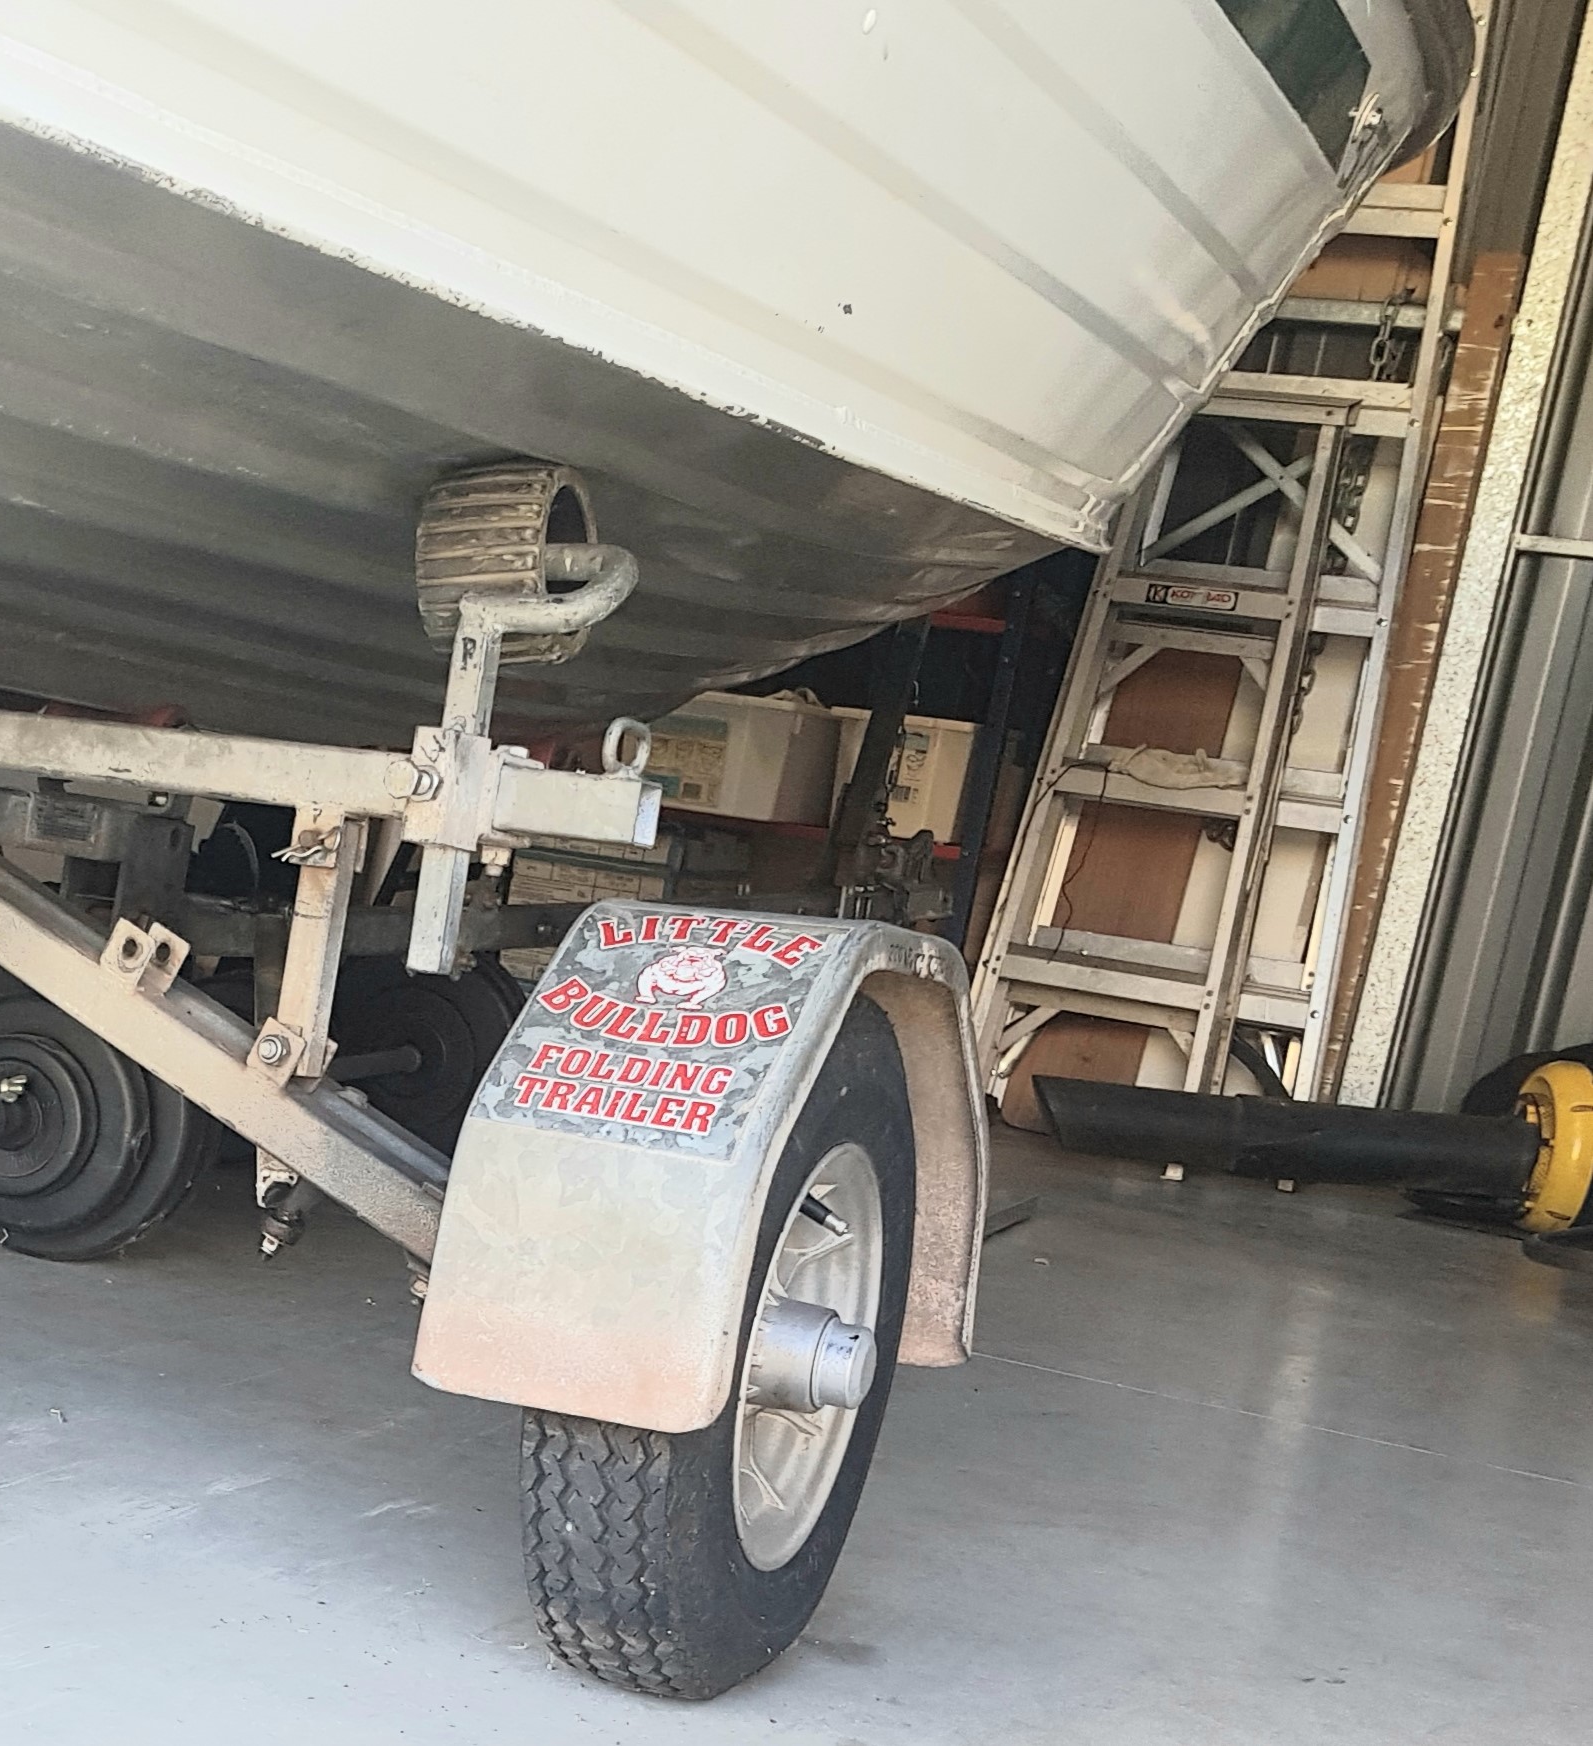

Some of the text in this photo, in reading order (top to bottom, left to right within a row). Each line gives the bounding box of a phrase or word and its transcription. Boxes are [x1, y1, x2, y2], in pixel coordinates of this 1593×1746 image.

[597, 914, 823, 967] LITTLE
[538, 975, 792, 1047] BULLDOG
[530, 1043, 734, 1097] FOLDING
[514, 1075, 717, 1135] TRAILER
